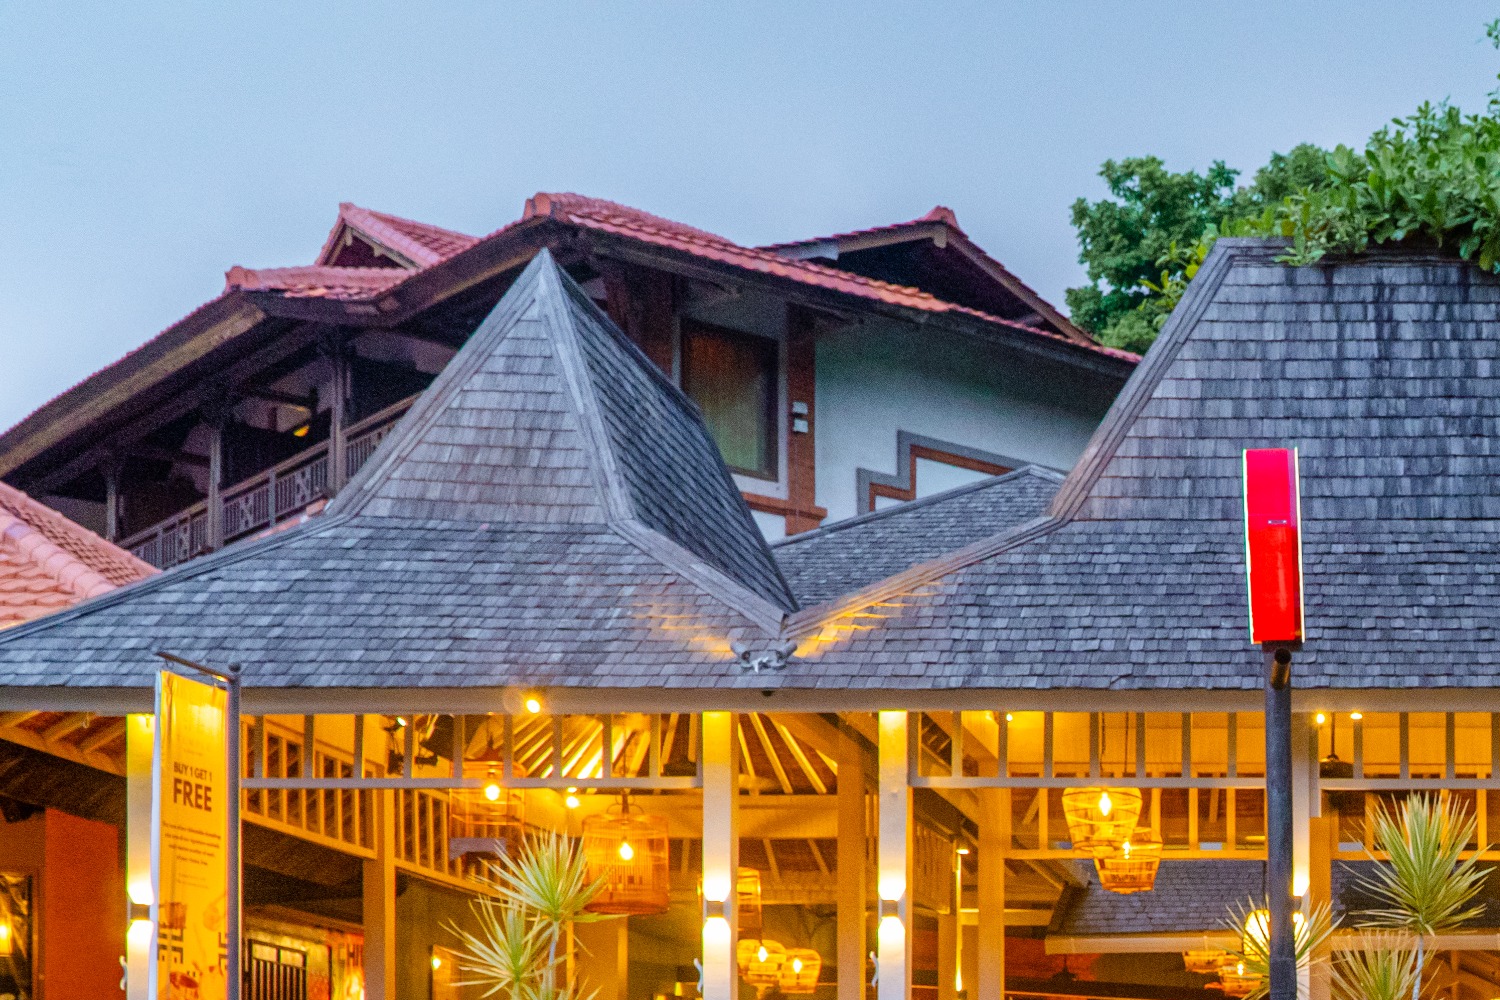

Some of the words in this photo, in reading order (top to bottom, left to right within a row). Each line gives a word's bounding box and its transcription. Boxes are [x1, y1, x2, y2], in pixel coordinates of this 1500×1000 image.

[173, 761, 189, 776] BUY
[194, 767, 207, 780] GET
[173, 776, 212, 812] FREE
